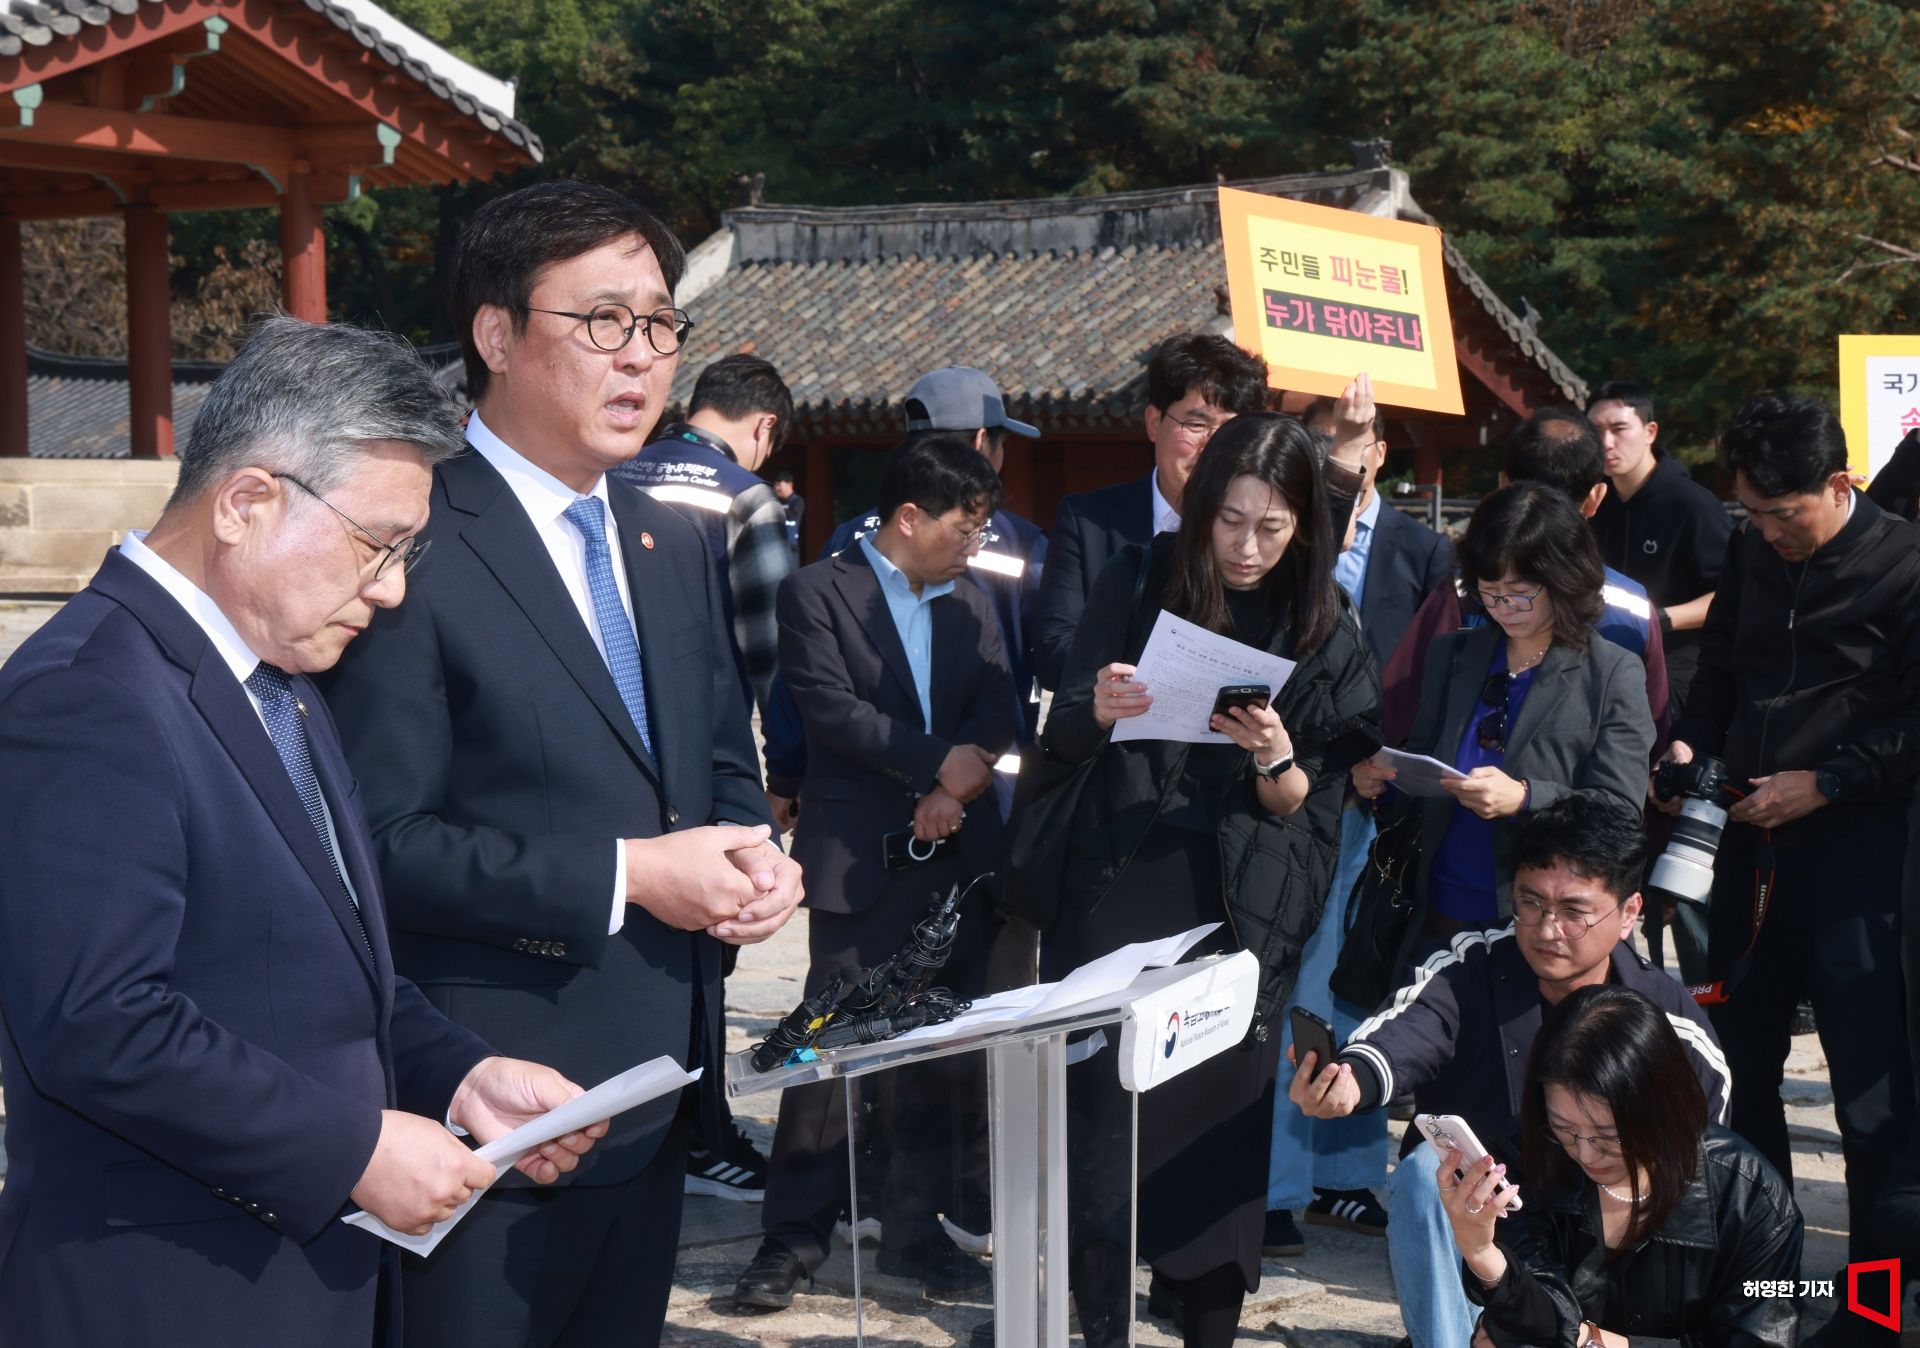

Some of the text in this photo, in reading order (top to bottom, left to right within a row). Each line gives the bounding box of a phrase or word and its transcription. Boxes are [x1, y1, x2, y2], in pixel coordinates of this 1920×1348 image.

[1259, 247, 1409, 295] 주민들 피눈물!
[1265, 295, 1421, 350] 누가 닦아주나
[664, 474, 689, 482] Tombs
[690, 475, 720, 488] Center
